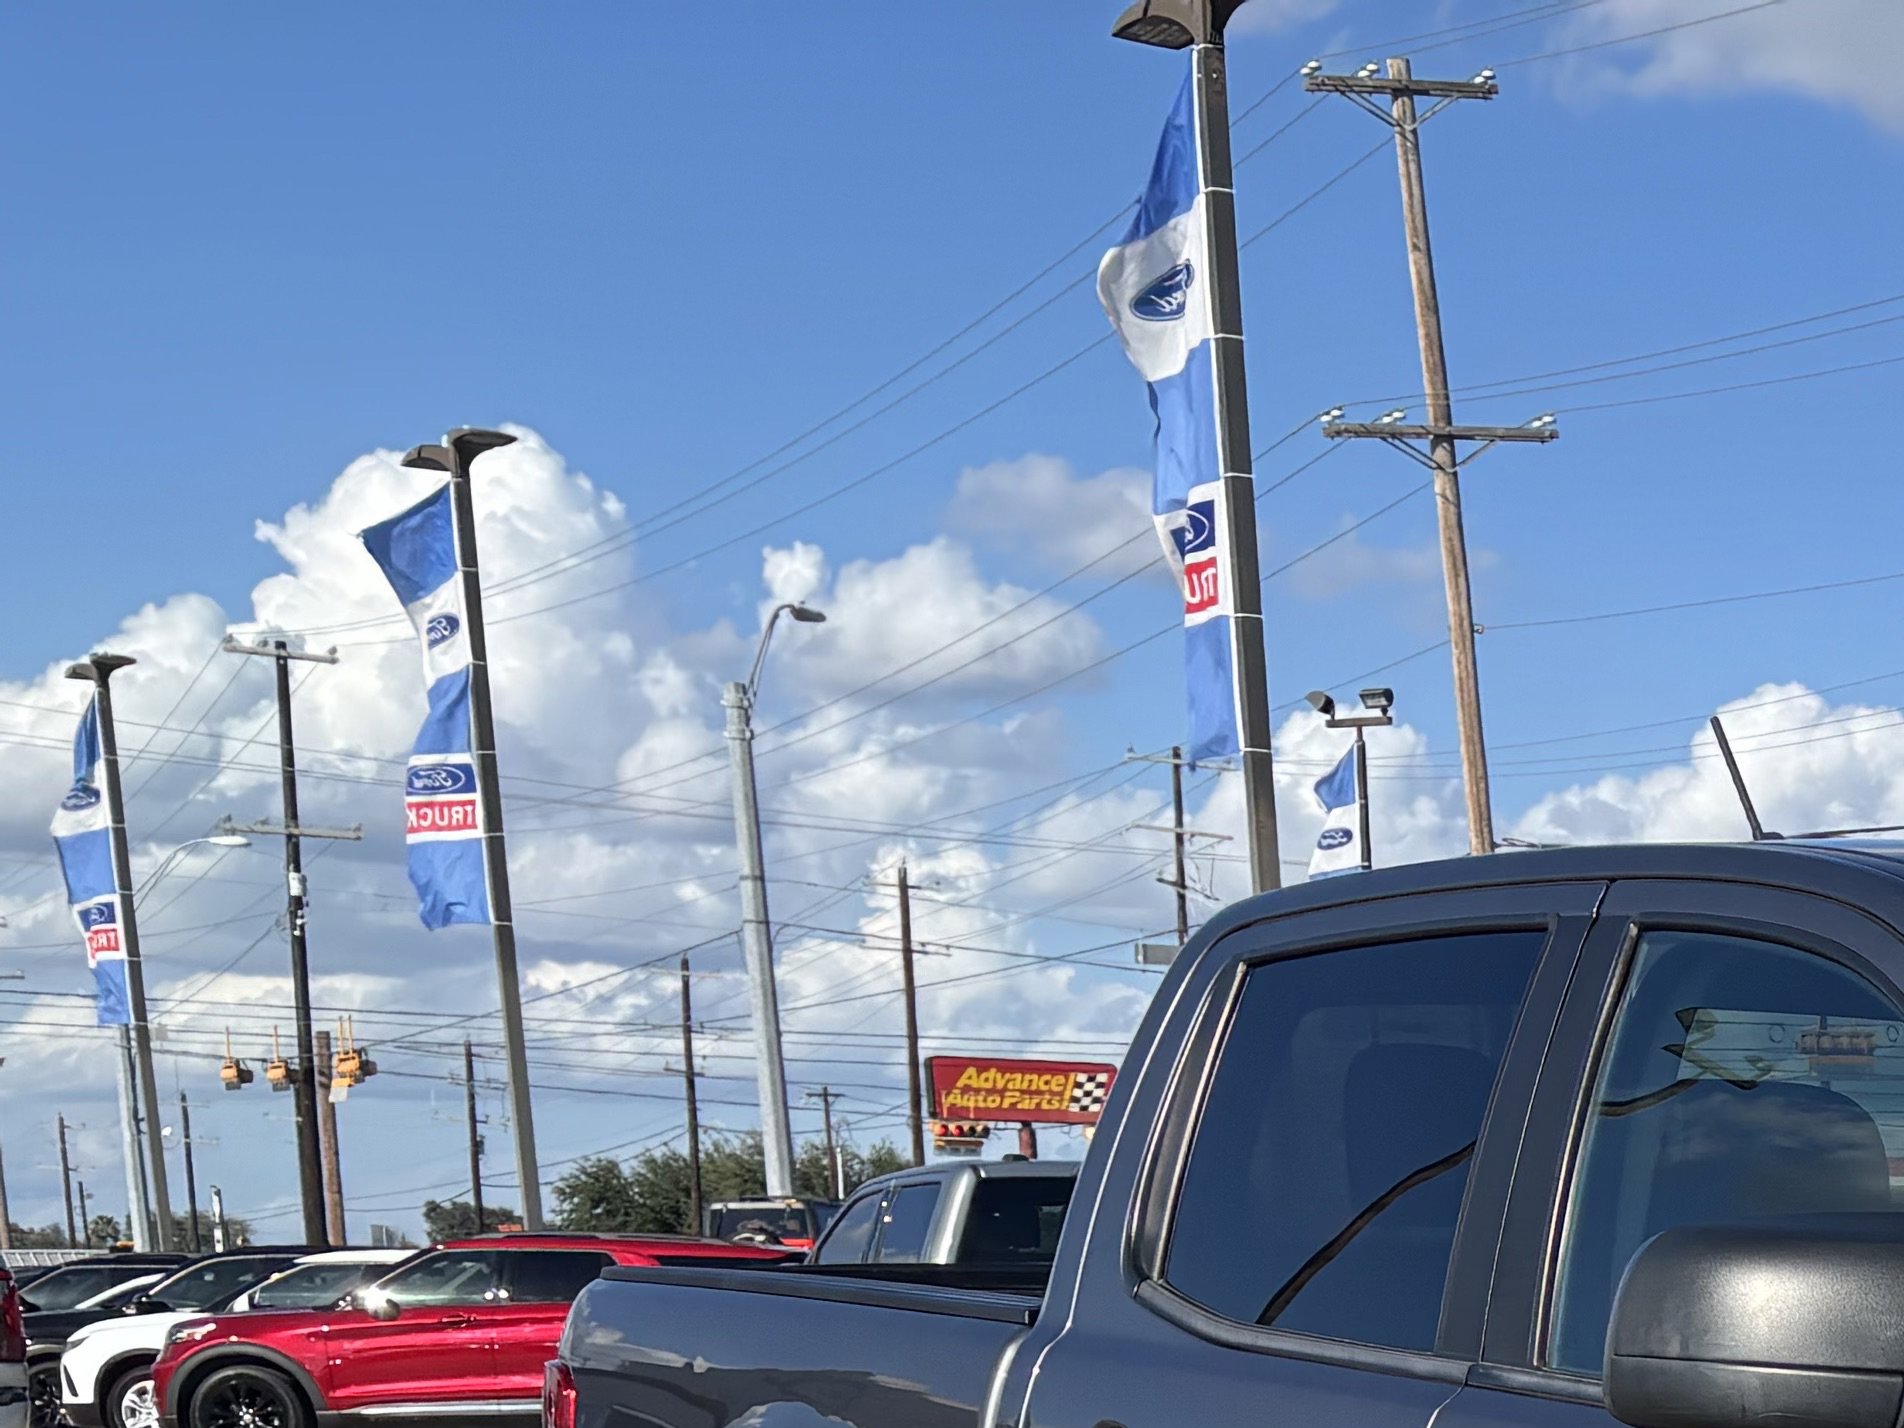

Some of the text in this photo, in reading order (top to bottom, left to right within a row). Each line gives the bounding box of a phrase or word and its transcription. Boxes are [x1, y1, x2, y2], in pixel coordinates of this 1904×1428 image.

[955, 1066, 1067, 1092] Advance
[944, 1089, 1062, 1111] Auto Parts
